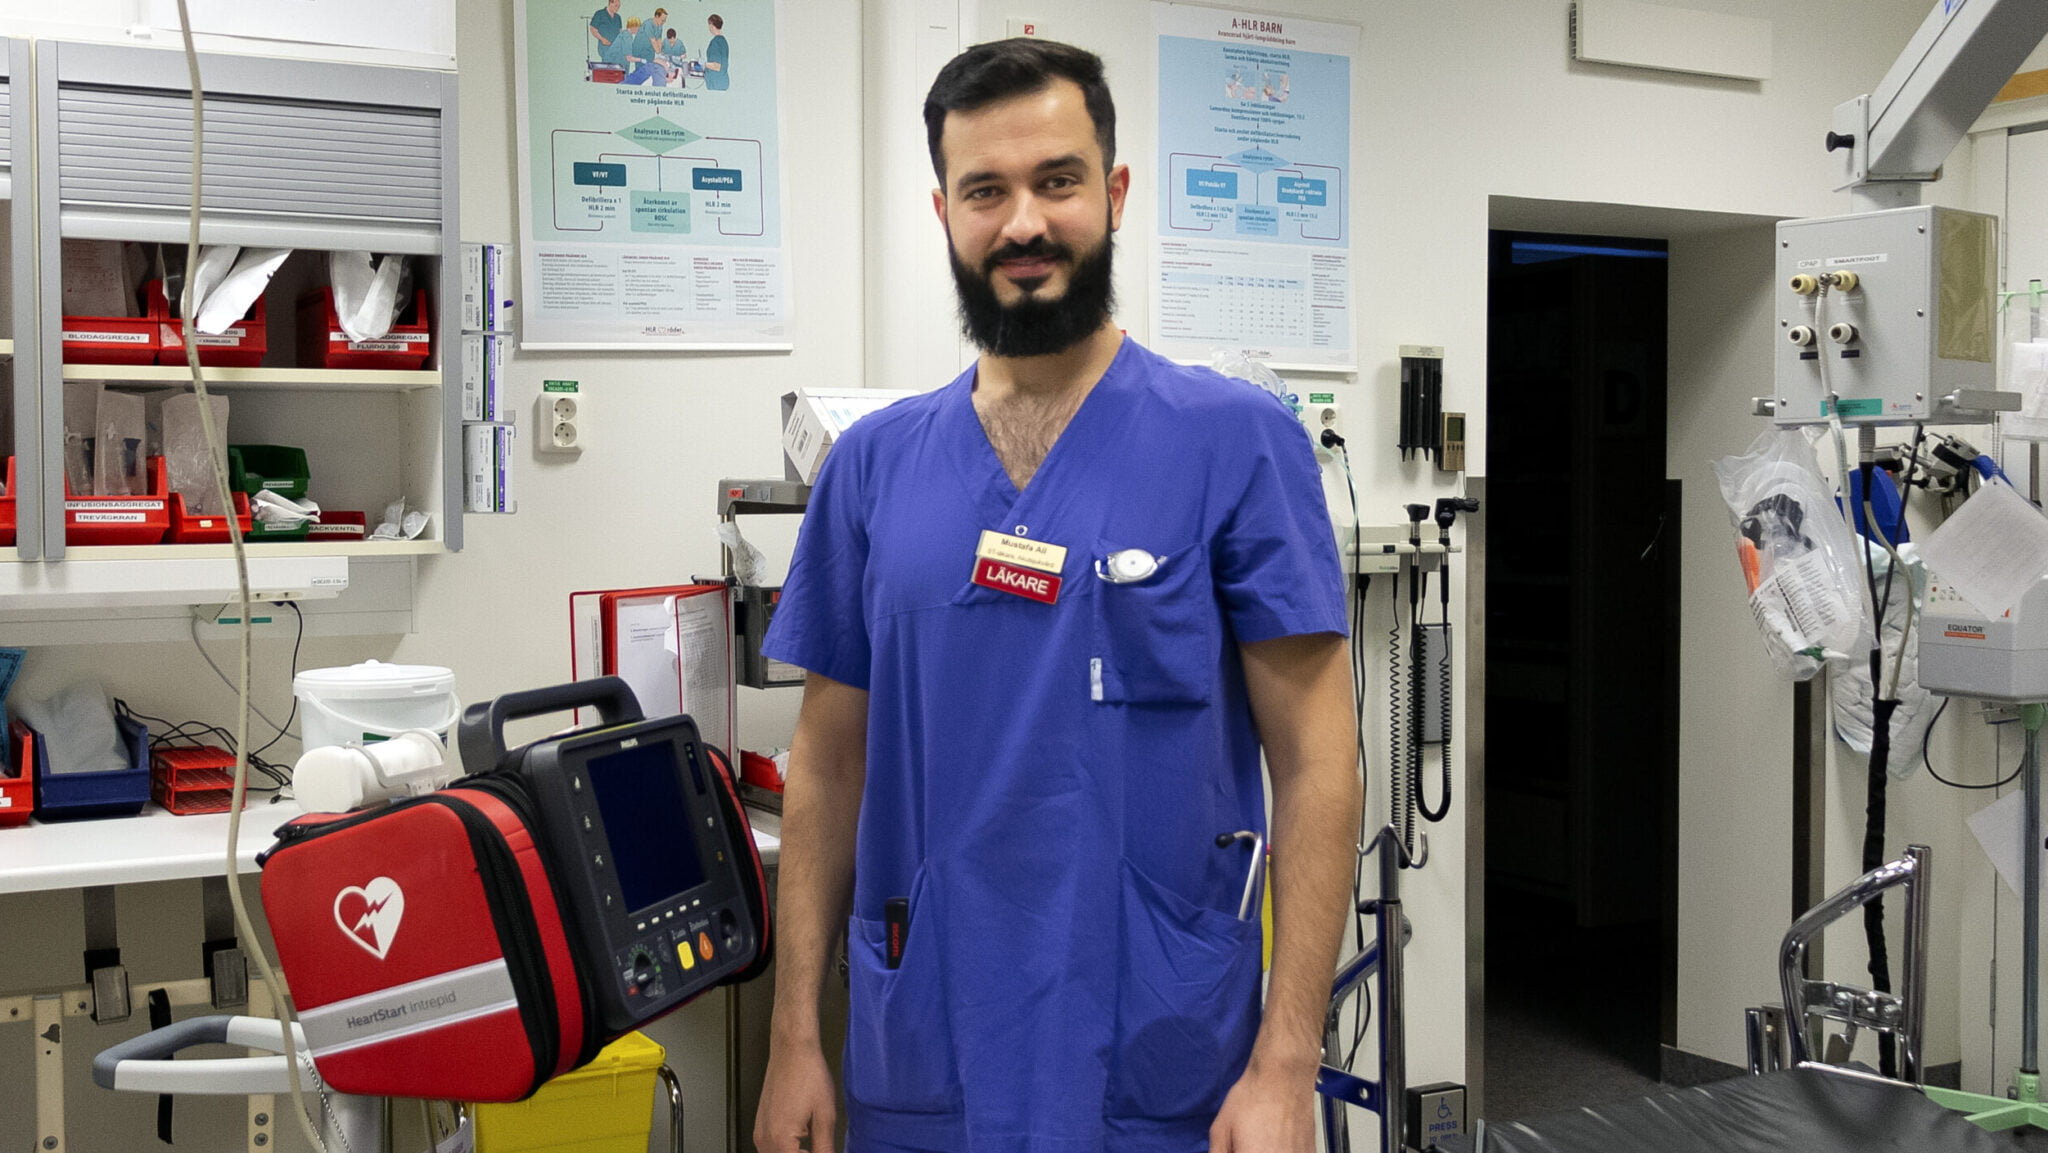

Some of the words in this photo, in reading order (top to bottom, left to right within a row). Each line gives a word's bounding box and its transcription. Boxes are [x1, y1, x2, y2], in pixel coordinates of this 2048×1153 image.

[1232, 18, 1258, 31] A-HLR
[1260, 21, 1283, 34] BARN
[662, 91, 698, 99] defibrillatorn
[634, 128, 660, 136] Analysera
[1001, 538, 1034, 552] Mustafa
[1035, 546, 1048, 555] Ali
[986, 565, 1050, 596] LÄKARE
[1948, 624, 1984, 632] EQUATOR
[891, 922, 900, 958] ascom
[346, 1005, 407, 1028] HeartStart
[409, 990, 457, 1014] Intrepid
[1429, 1120, 1457, 1132] PRESS
